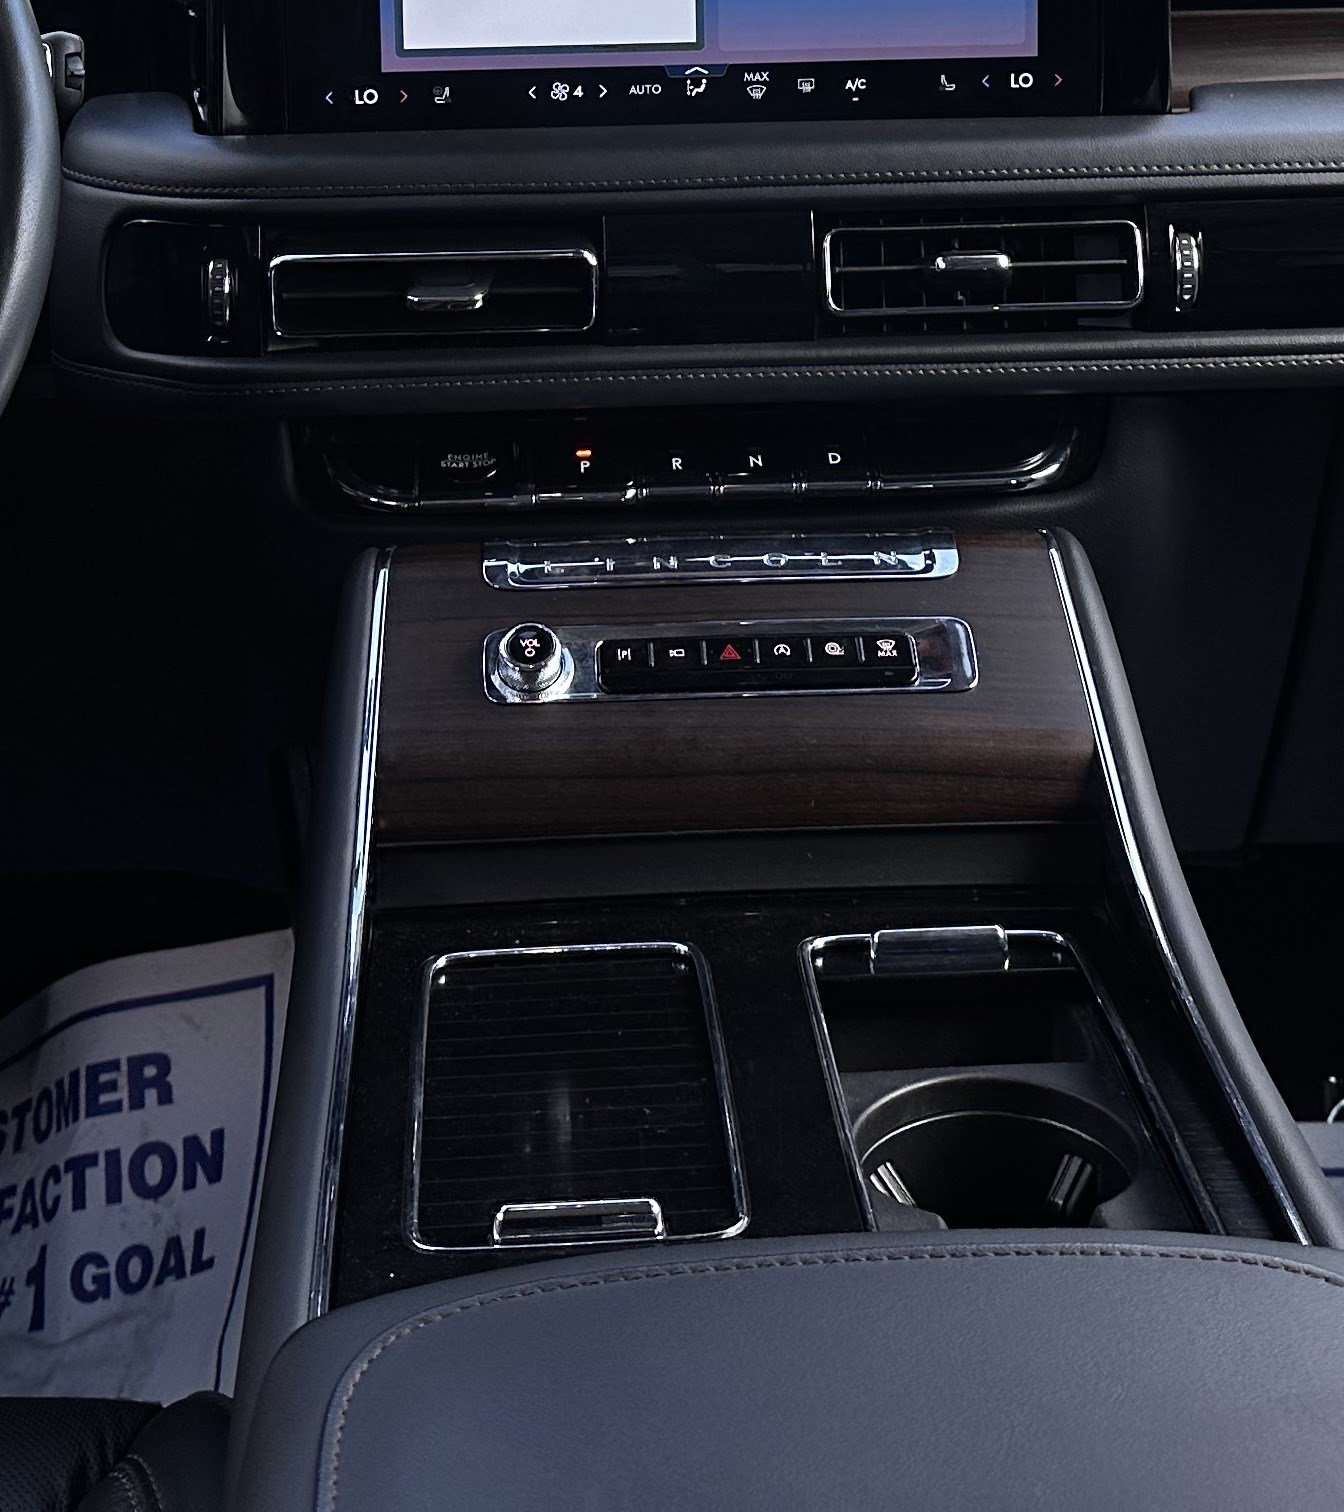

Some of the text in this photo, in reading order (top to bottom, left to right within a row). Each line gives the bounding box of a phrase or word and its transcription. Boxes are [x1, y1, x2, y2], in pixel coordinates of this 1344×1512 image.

[744, 71, 770, 82] MAX
[1010, 72, 1034, 88] LO
[629, 84, 662, 95] AUTO
[845, 77, 867, 91] A/C
[354, 88, 378, 105] LO
[573, 85, 584, 98] 4
[440, 459, 469, 469] START
[671, 457, 683, 470] R
[749, 454, 763, 467] N
[827, 451, 842, 465] D
[580, 460, 591, 473] P
[543, 551, 897, 573] LINCOLN
[519, 638, 541, 648] VOL
[877, 649, 898, 657] MAX
[69, 1226, 216, 1304] GOAL
